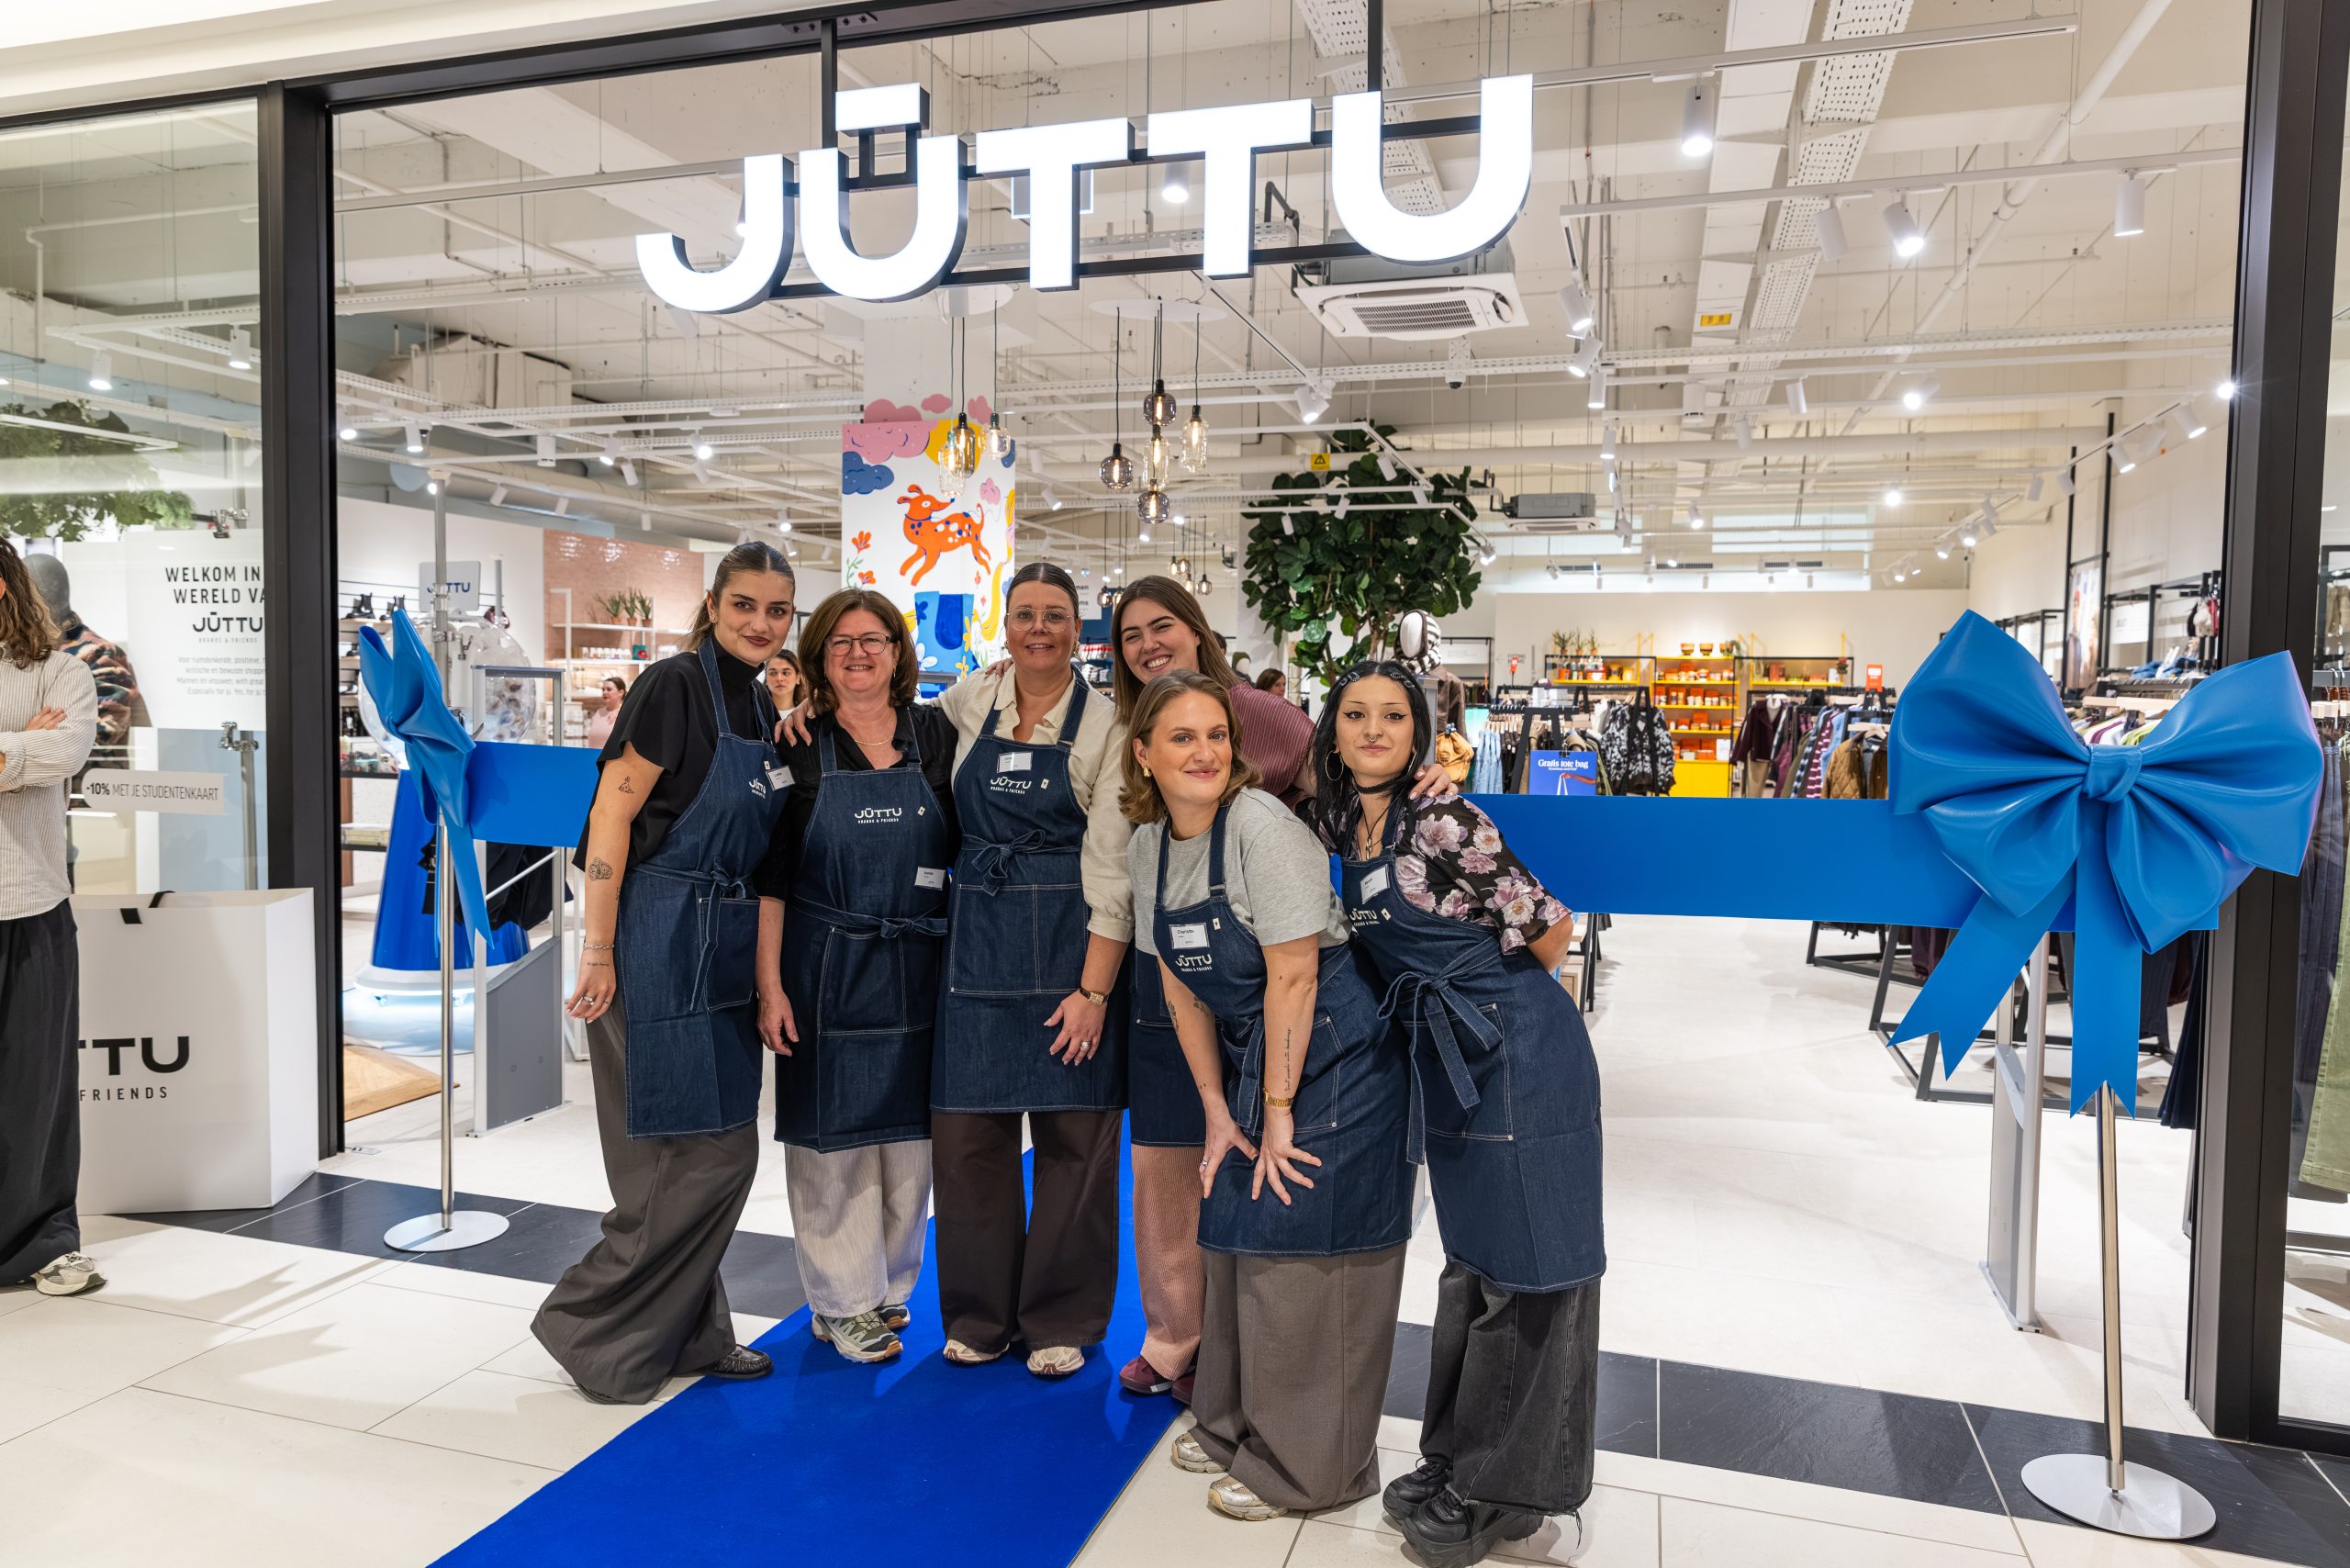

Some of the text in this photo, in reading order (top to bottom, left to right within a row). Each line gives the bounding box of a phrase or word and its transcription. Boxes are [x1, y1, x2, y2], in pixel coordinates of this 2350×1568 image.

[636, 74, 1533, 313] JŪTTU
[165, 566, 261, 582] WELKOM IN
[173, 588, 241, 604] WERELD
[193, 611, 263, 633] JŪTTU
[1575, 759, 1589, 769] bag
[990, 776, 1032, 789] JŪTTU
[86, 782, 219, 801] -10% MET JE STUDENTENKAART
[855, 807, 902, 819] JŪTTU
[1175, 954, 1212, 967] JŪTTU
[78, 1036, 190, 1075] TU
[79, 1087, 168, 1102] FRIENDS
